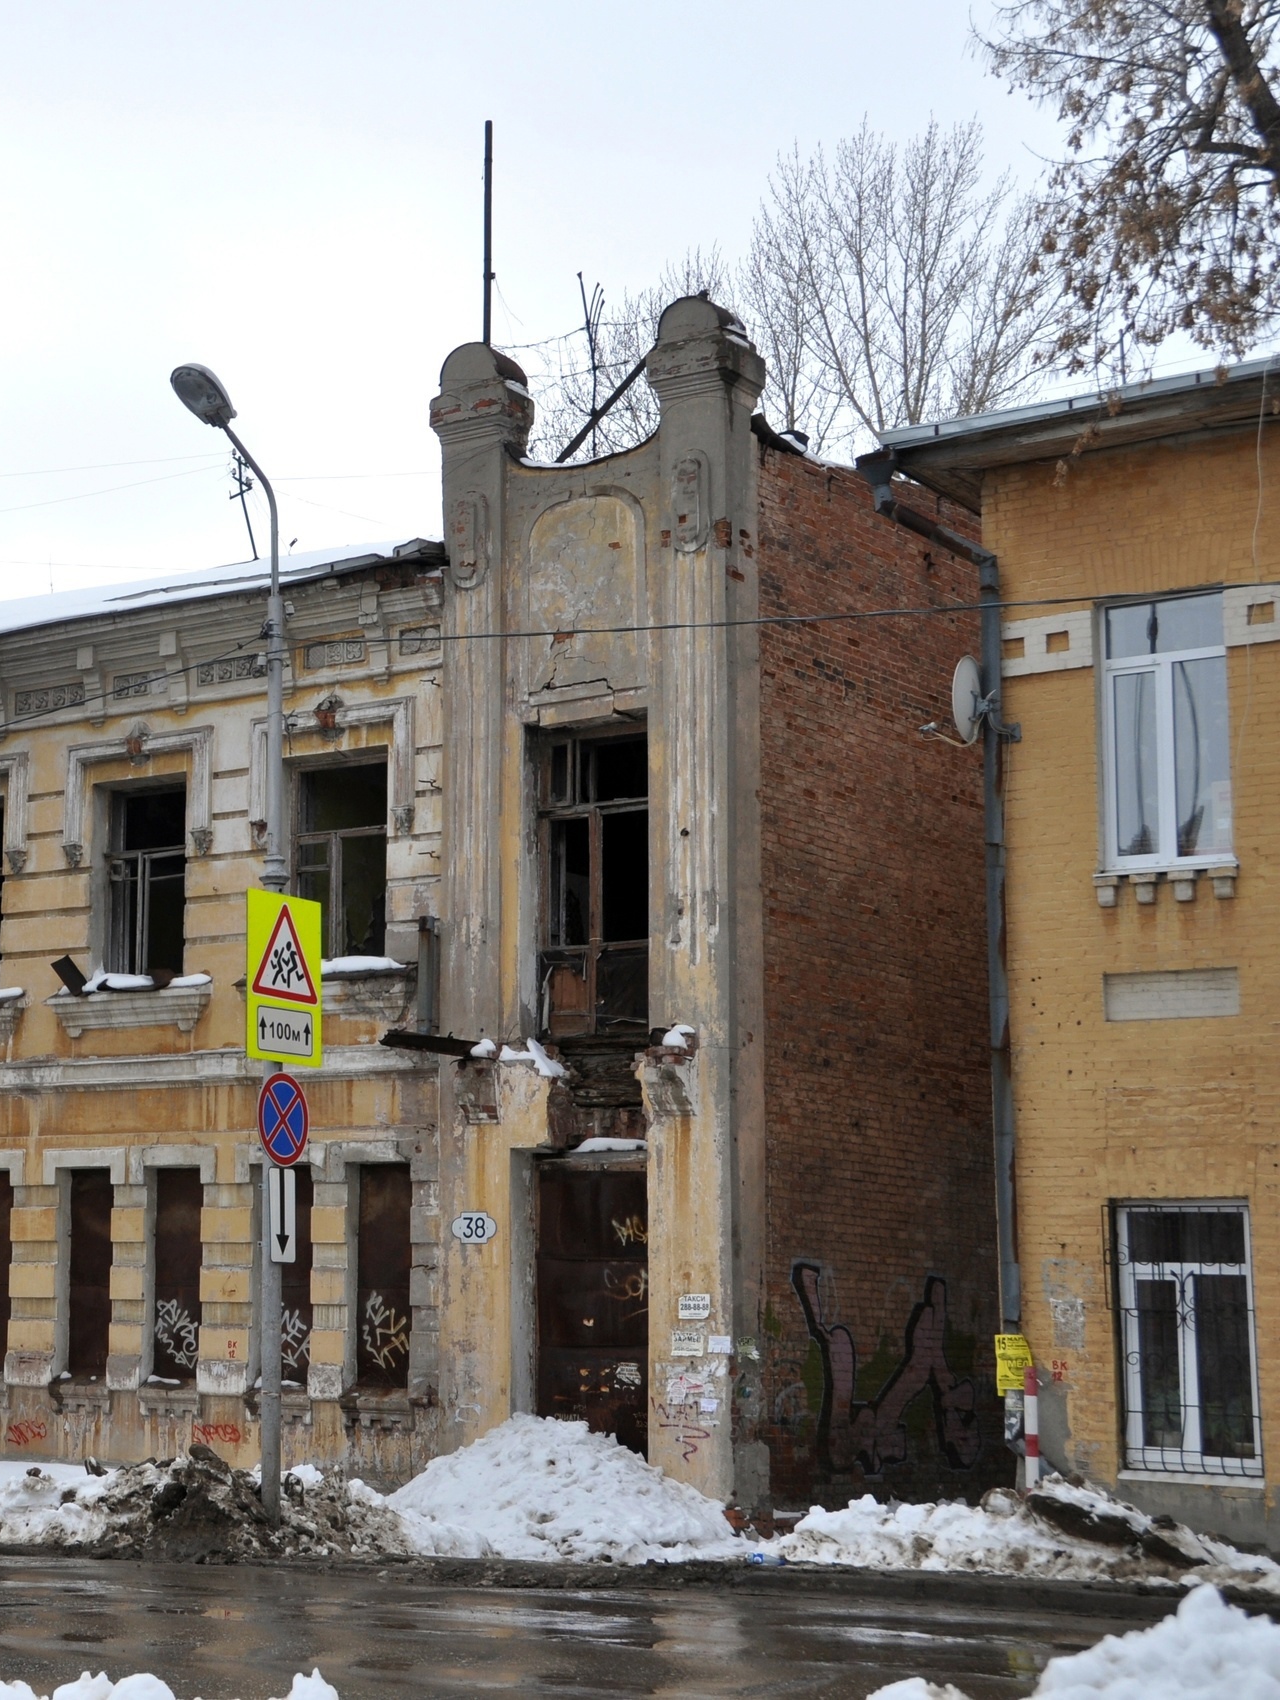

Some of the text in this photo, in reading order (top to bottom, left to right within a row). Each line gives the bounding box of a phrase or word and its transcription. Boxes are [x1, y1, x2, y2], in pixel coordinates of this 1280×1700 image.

[463, 1217, 486, 1238] 38
[680, 1303, 709, 1311] 288-88-88
[997, 1336, 1007, 1351] 15
[228, 1350, 236, 1359] 12
[1052, 1371, 1063, 1382] 12
